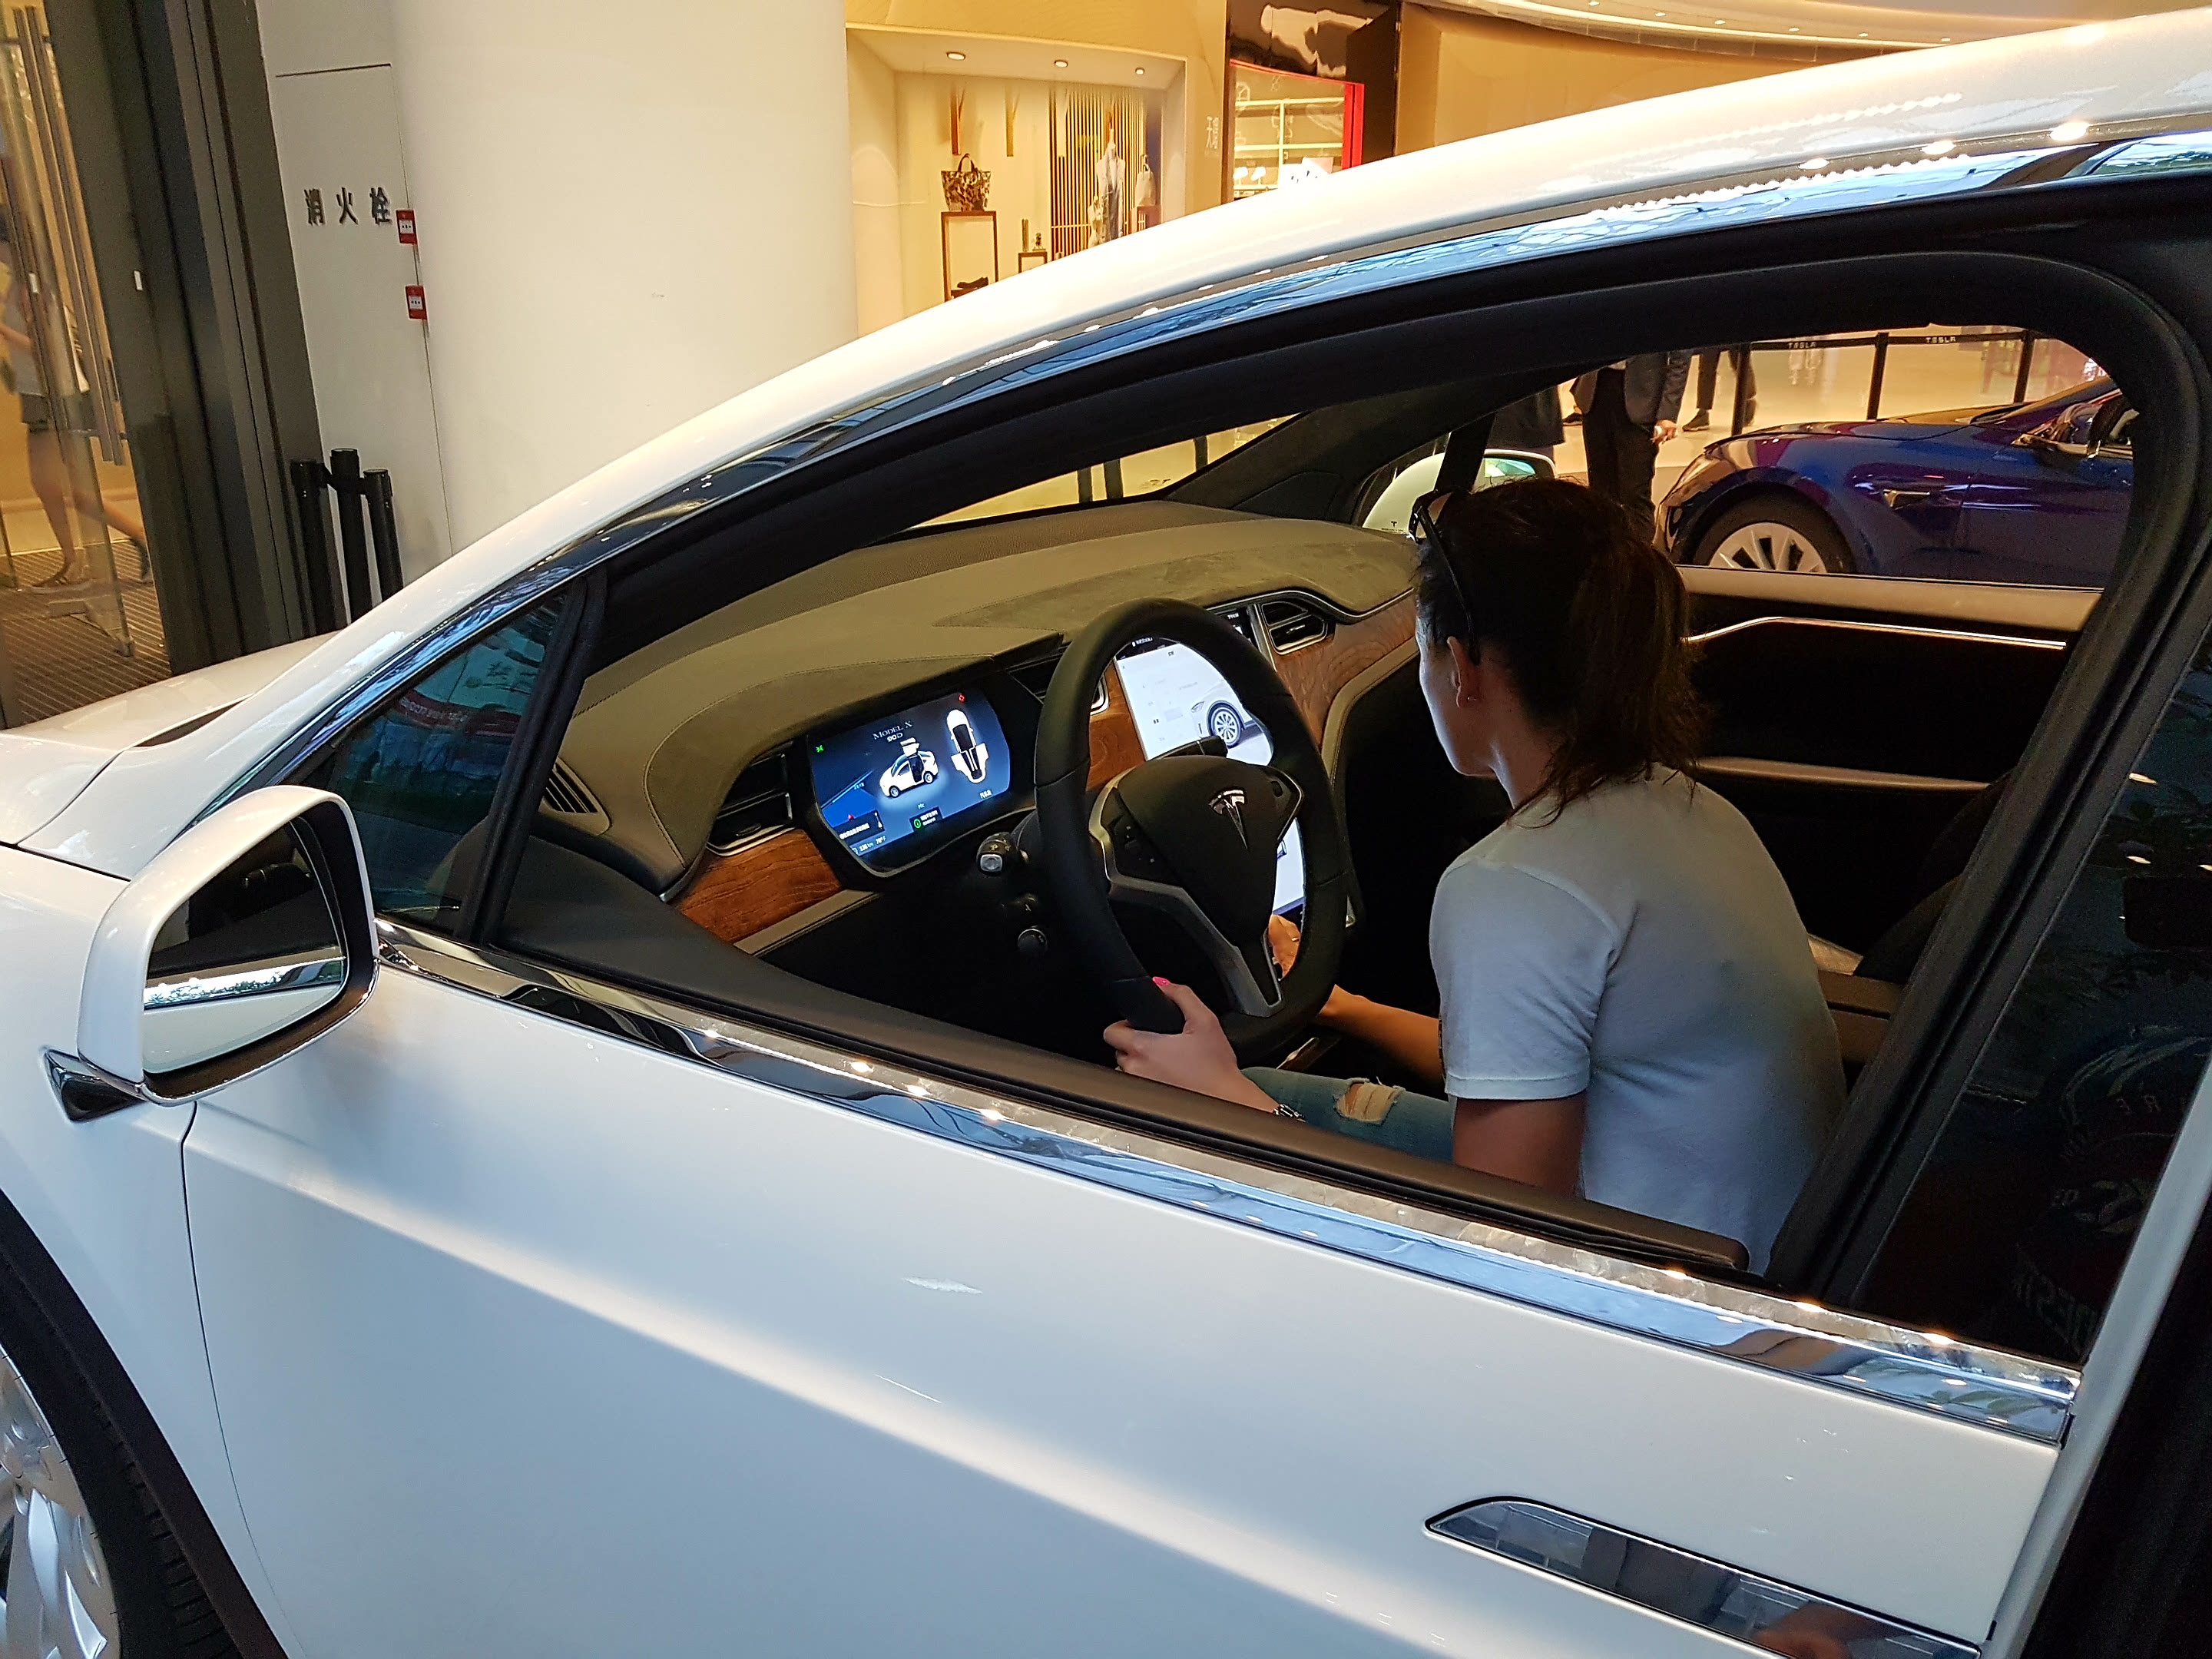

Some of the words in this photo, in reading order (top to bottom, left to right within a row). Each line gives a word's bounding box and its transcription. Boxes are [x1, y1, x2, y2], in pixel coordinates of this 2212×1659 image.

[304, 187, 392, 225] 消火栓
[873, 726, 903, 740] MODEL
